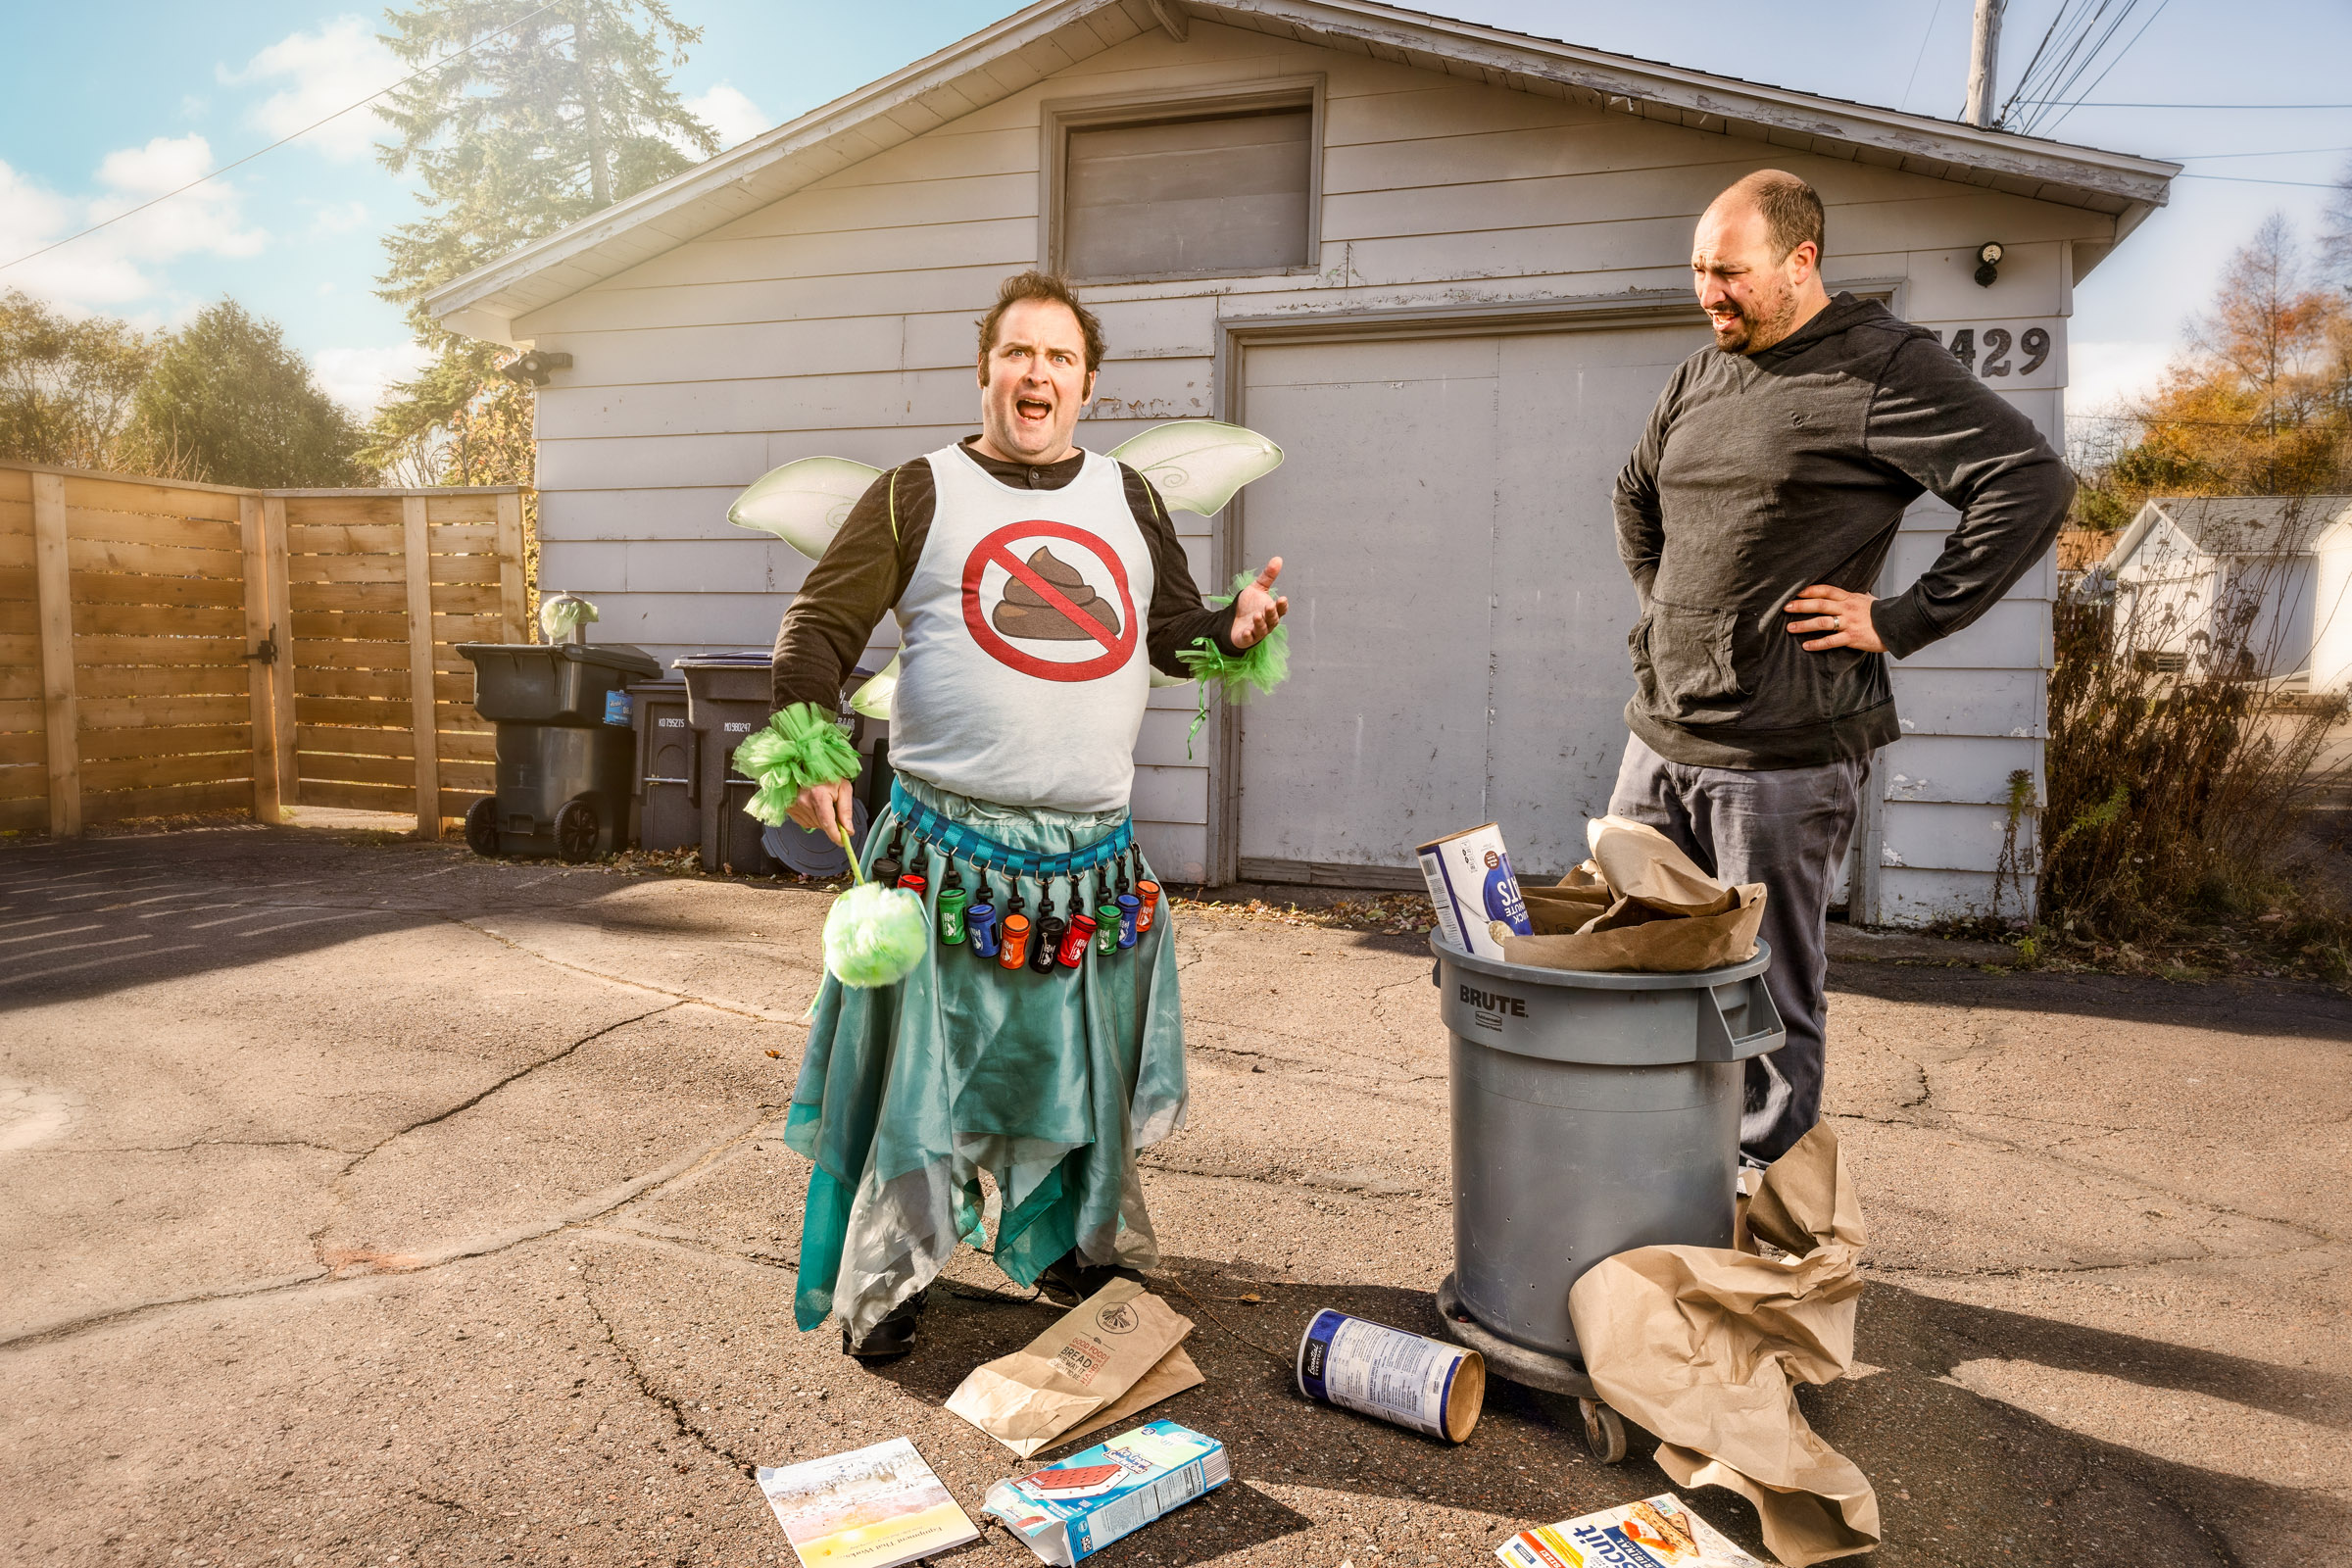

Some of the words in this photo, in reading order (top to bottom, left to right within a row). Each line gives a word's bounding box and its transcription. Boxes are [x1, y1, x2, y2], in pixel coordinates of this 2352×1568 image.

[1934, 327, 2051, 378] 429
[1497, 876, 1522, 906] ATS
[1459, 984, 1526, 1018] BRUTE
[1060, 1346, 1093, 1368] BREAD
[1072, 1337, 1091, 1349] GOOD
[1089, 1346, 1107, 1360] FOOD
[1056, 1353, 1067, 1364] THE
[1065, 1359, 1079, 1372] WAY
[1078, 1366, 1086, 1375] IT
[1080, 1363, 1099, 1385] HAND
[1616, 1538, 1653, 1568] RIGINAL
